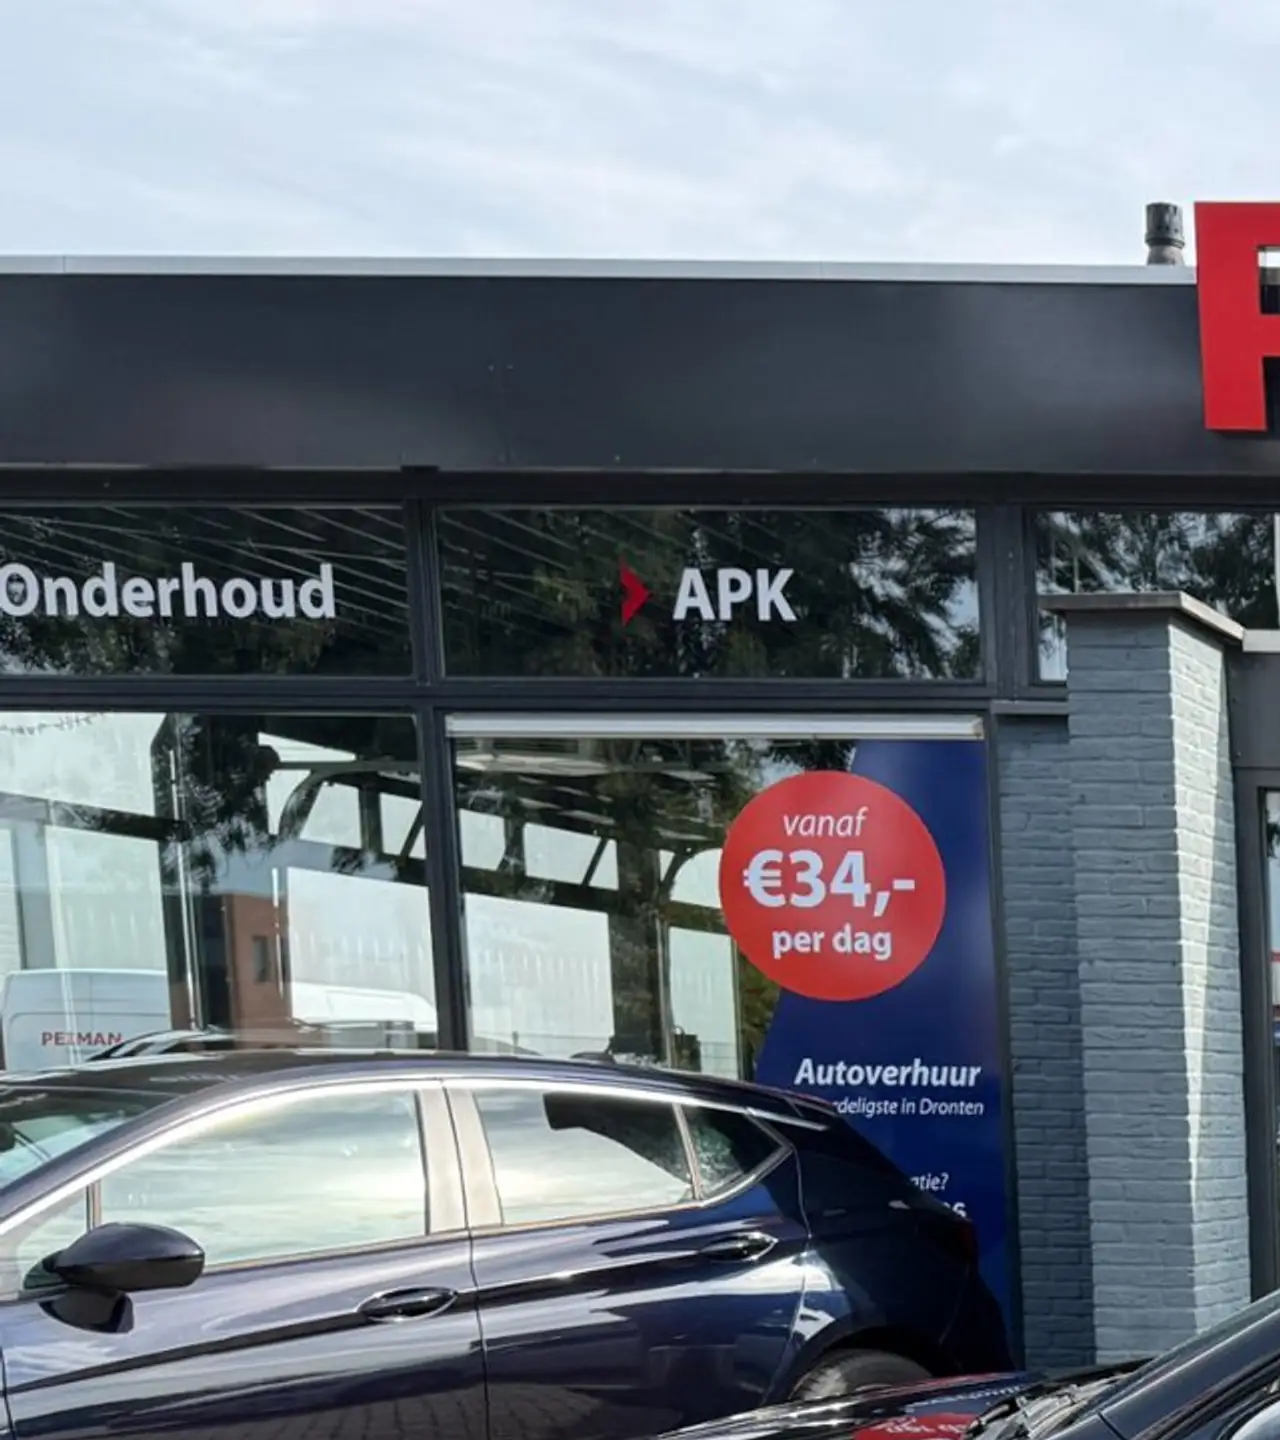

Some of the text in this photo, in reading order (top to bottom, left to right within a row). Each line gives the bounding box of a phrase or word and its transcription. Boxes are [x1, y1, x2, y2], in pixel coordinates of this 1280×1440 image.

[0, 562, 336, 619] Onderhoud
[673, 568, 798, 621] APK
[783, 806, 869, 838] vanaf
[742, 850, 917, 918] €34,-
[772, 923, 893, 961] per dag
[41, 1031, 123, 1046] PEIMAN
[794, 1058, 982, 1087] Autoverhuur
[901, 1098, 915, 1115] in
[919, 1098, 984, 1116] Dronten
